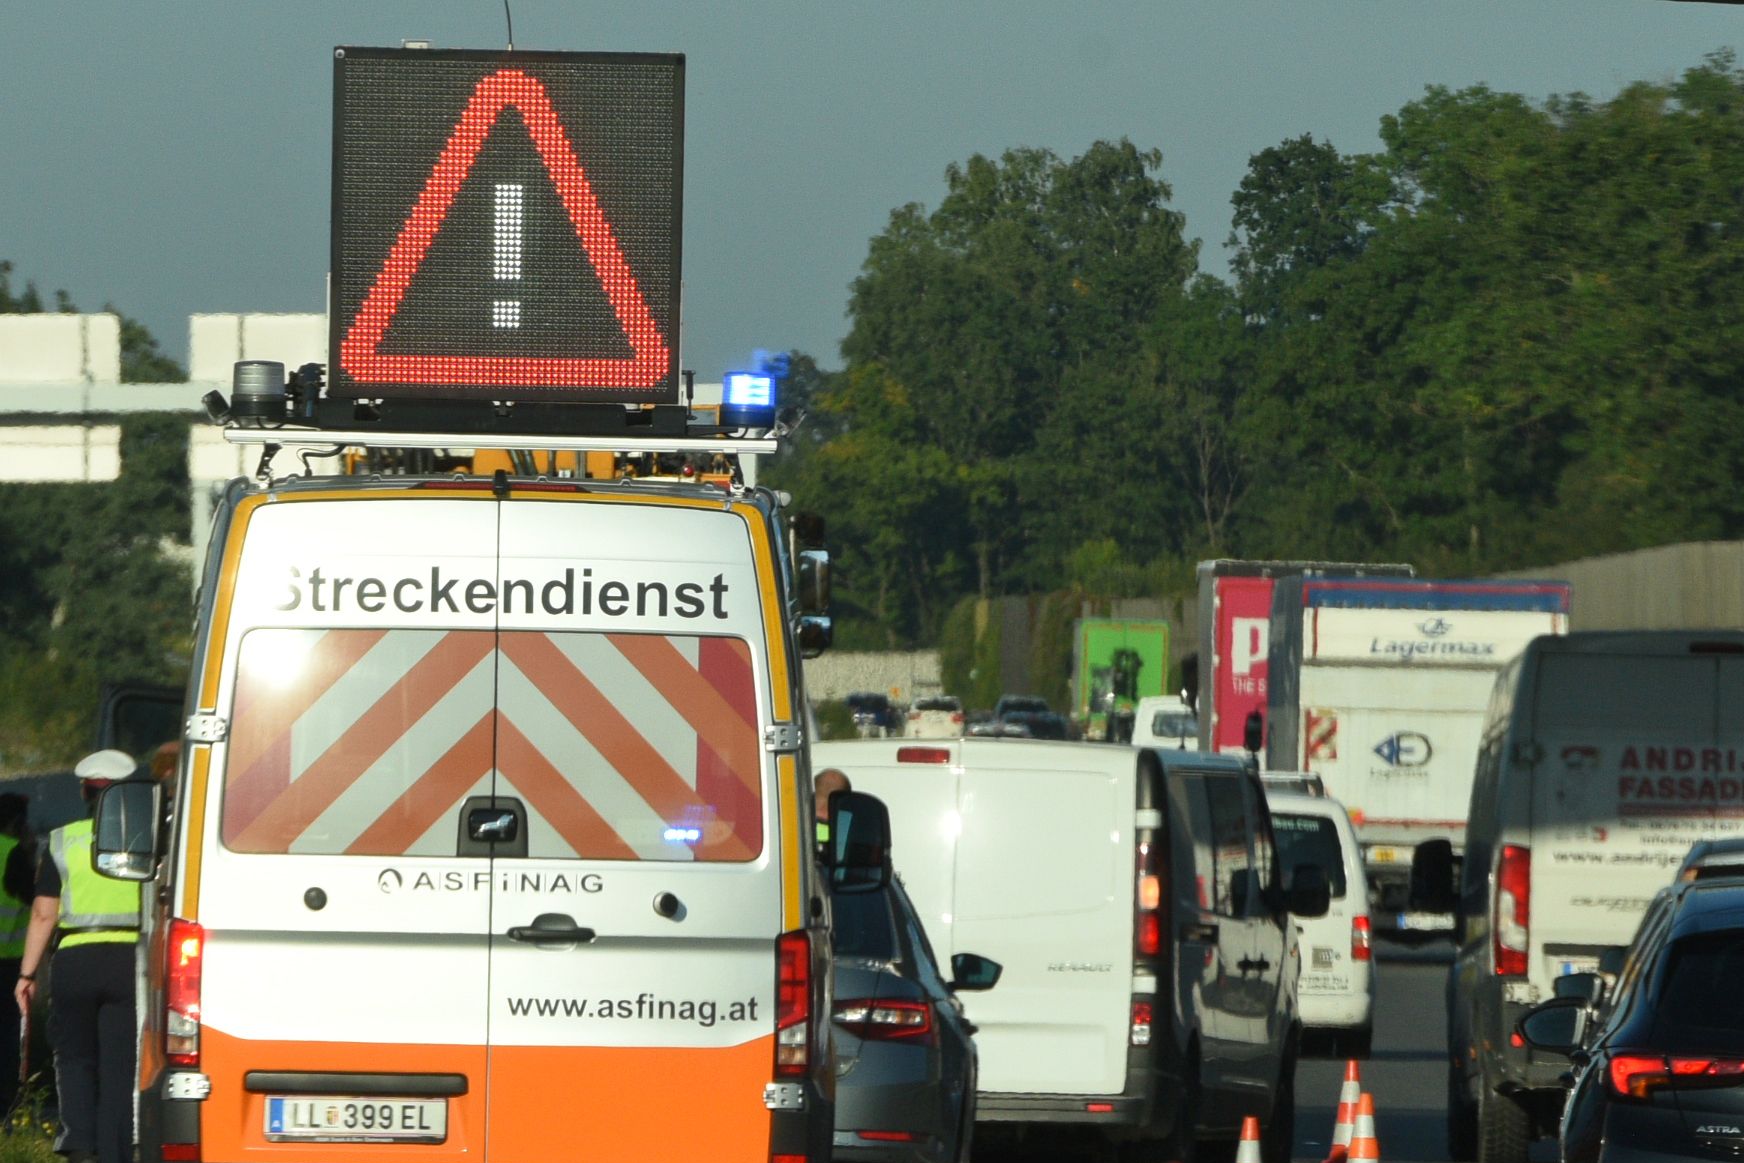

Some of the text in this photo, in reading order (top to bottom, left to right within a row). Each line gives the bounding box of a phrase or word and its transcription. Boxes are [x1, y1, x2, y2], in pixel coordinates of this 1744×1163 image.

[1370, 637, 1495, 661] Lagermax
[507, 993, 759, 1027] www.asfinag.at
[292, 1103, 322, 1129] LL
[344, 1103, 393, 1129] 399
[401, 1104, 431, 1130] EL
[1696, 1125, 1741, 1134] ASTRA
